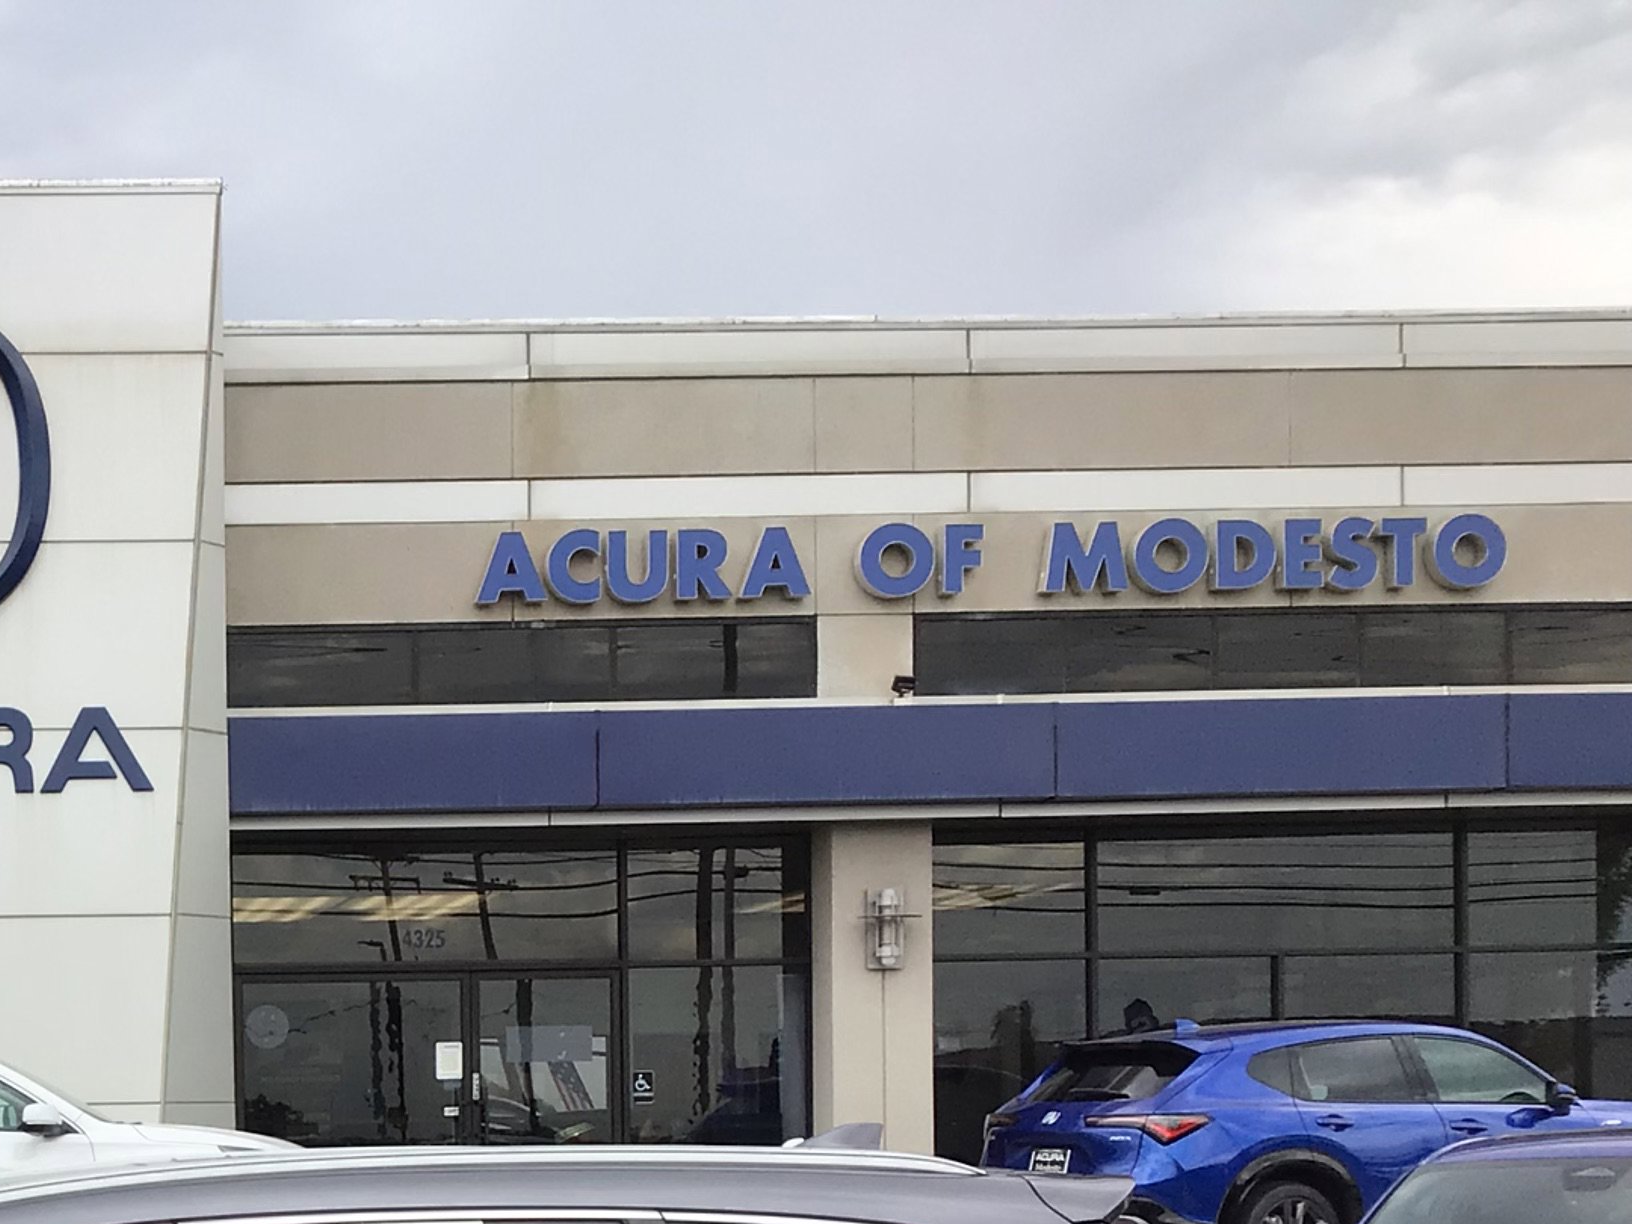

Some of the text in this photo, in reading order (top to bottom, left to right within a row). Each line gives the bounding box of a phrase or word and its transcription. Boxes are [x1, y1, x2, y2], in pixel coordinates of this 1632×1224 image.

[475, 513, 1508, 606] ACURA OF MODESTO
[402, 929, 446, 949] 4325
[1035, 1152, 1065, 1161] ACURA
